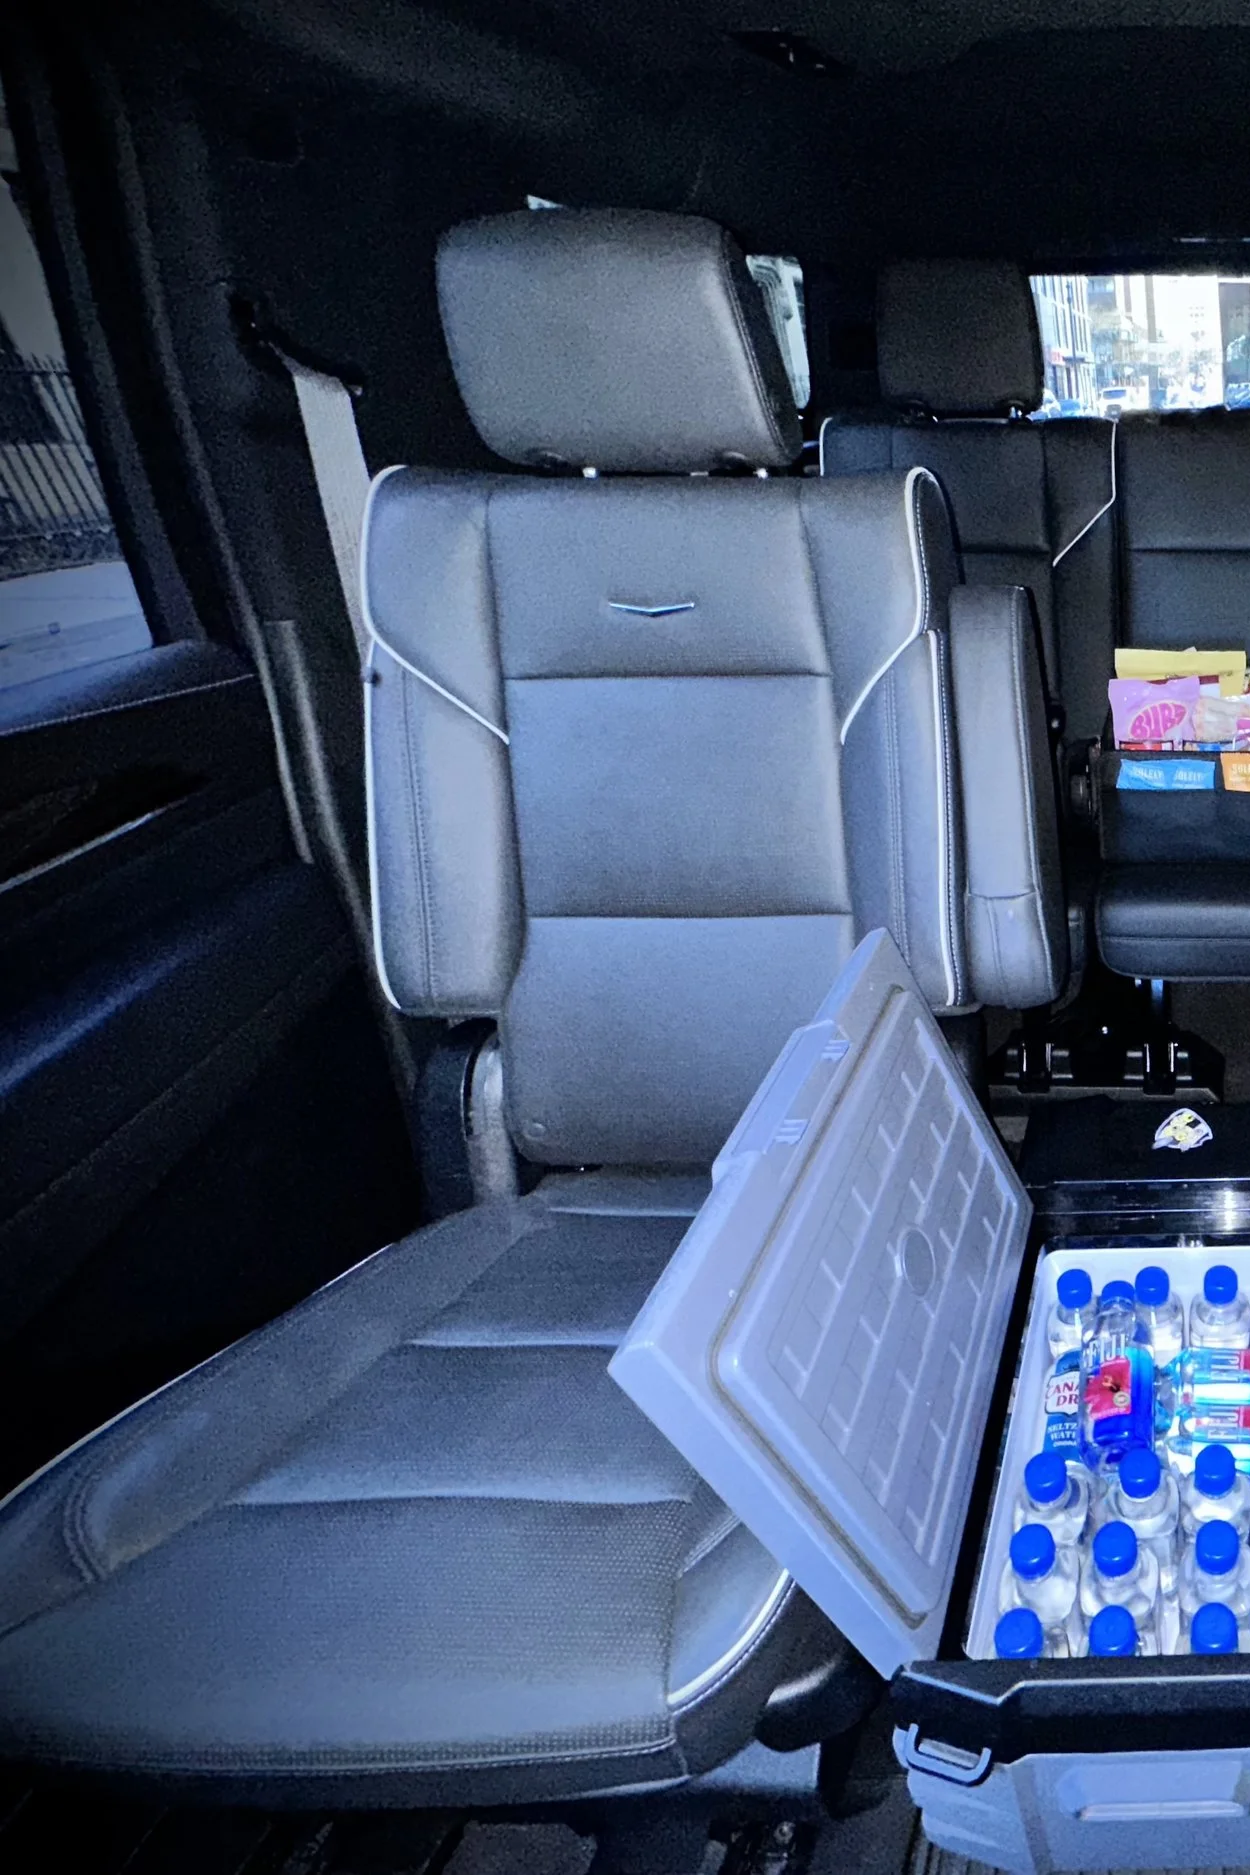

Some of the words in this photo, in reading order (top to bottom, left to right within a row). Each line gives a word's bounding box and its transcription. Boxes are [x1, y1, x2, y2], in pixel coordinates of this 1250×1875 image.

[1088, 1333, 1126, 1367] FIJI
[1210, 1350, 1239, 1381] FIJI
[1056, 1393, 1079, 1407] DR
[1047, 1422, 1078, 1434] SELTZ
[1207, 1406, 1239, 1439] FIJI
